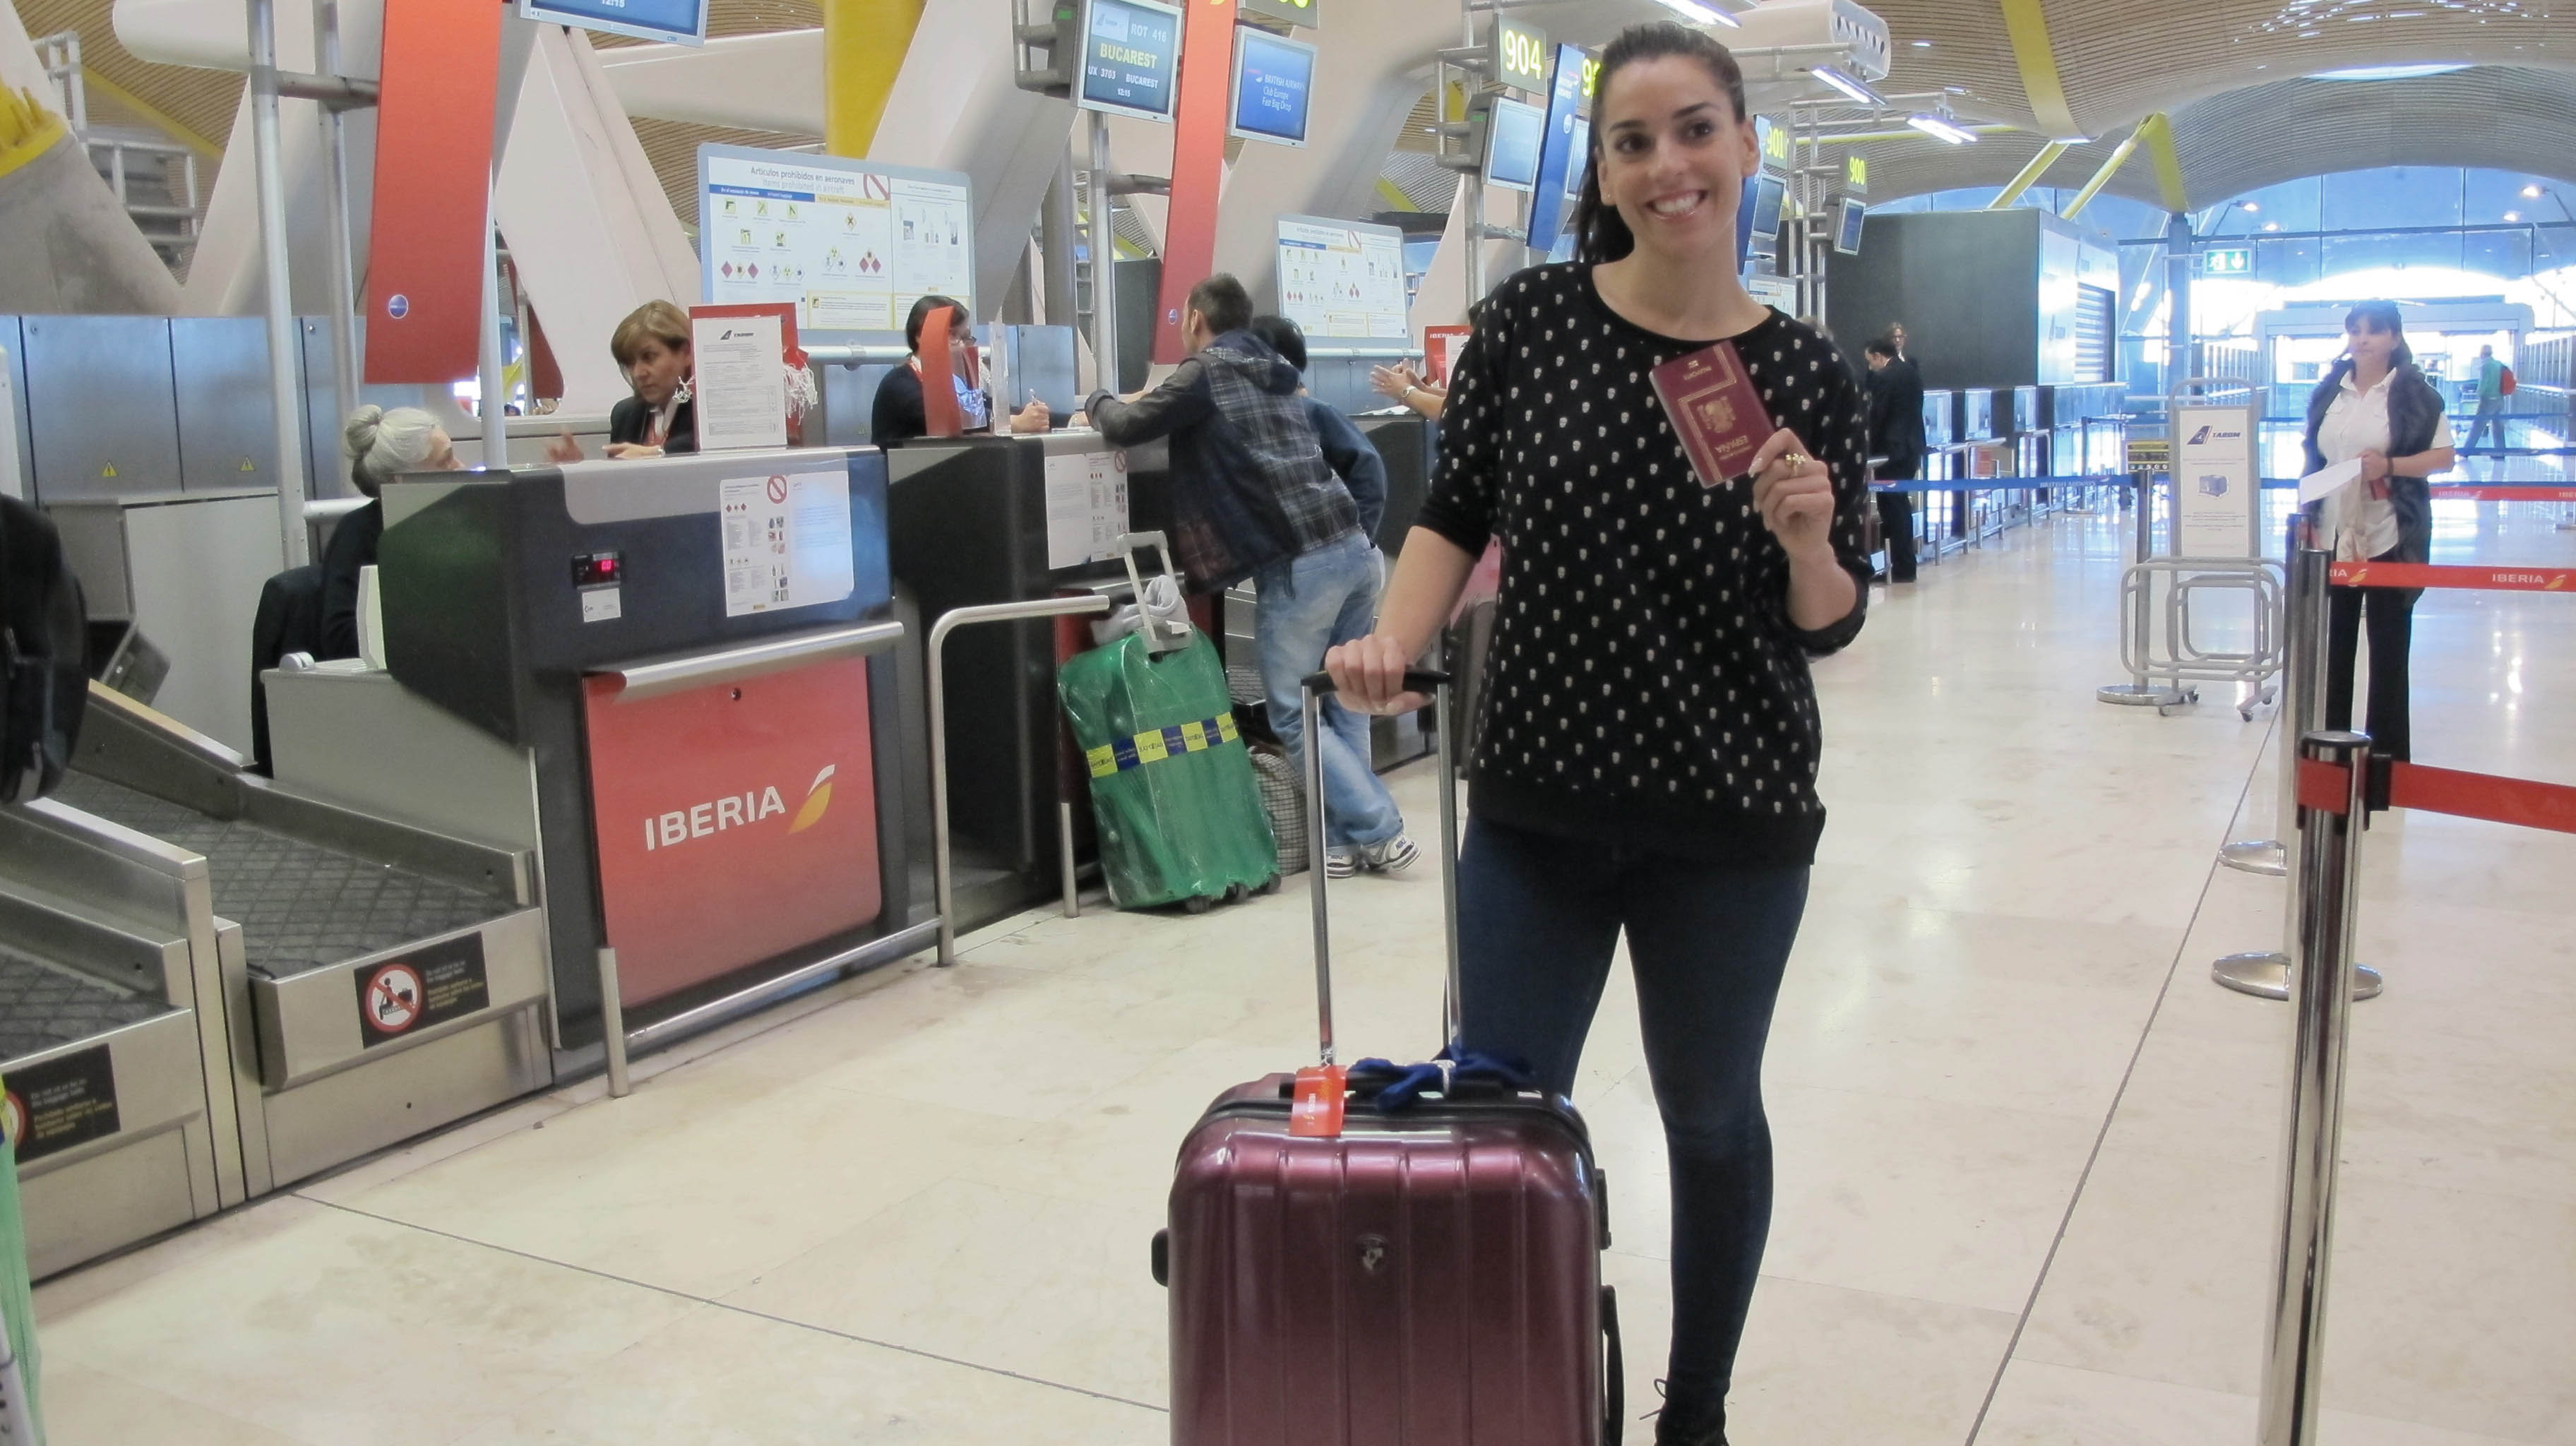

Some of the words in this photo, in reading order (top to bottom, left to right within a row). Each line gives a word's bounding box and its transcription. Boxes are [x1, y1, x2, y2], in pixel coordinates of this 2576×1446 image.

[1131, 23, 1149, 38] ROT
[1152, 29, 1167, 42] 416
[1100, 43, 1157, 68] BUCAREST
[1504, 29, 1542, 80] 904
[1087, 65, 1098, 76] UX
[1126, 73, 1158, 89] BUCAREST
[1117, 88, 1131, 97] 12:15
[1849, 155, 1866, 186] 900
[2492, 573, 2545, 585] IBERIA
[645, 785, 786, 852] IBERIA
